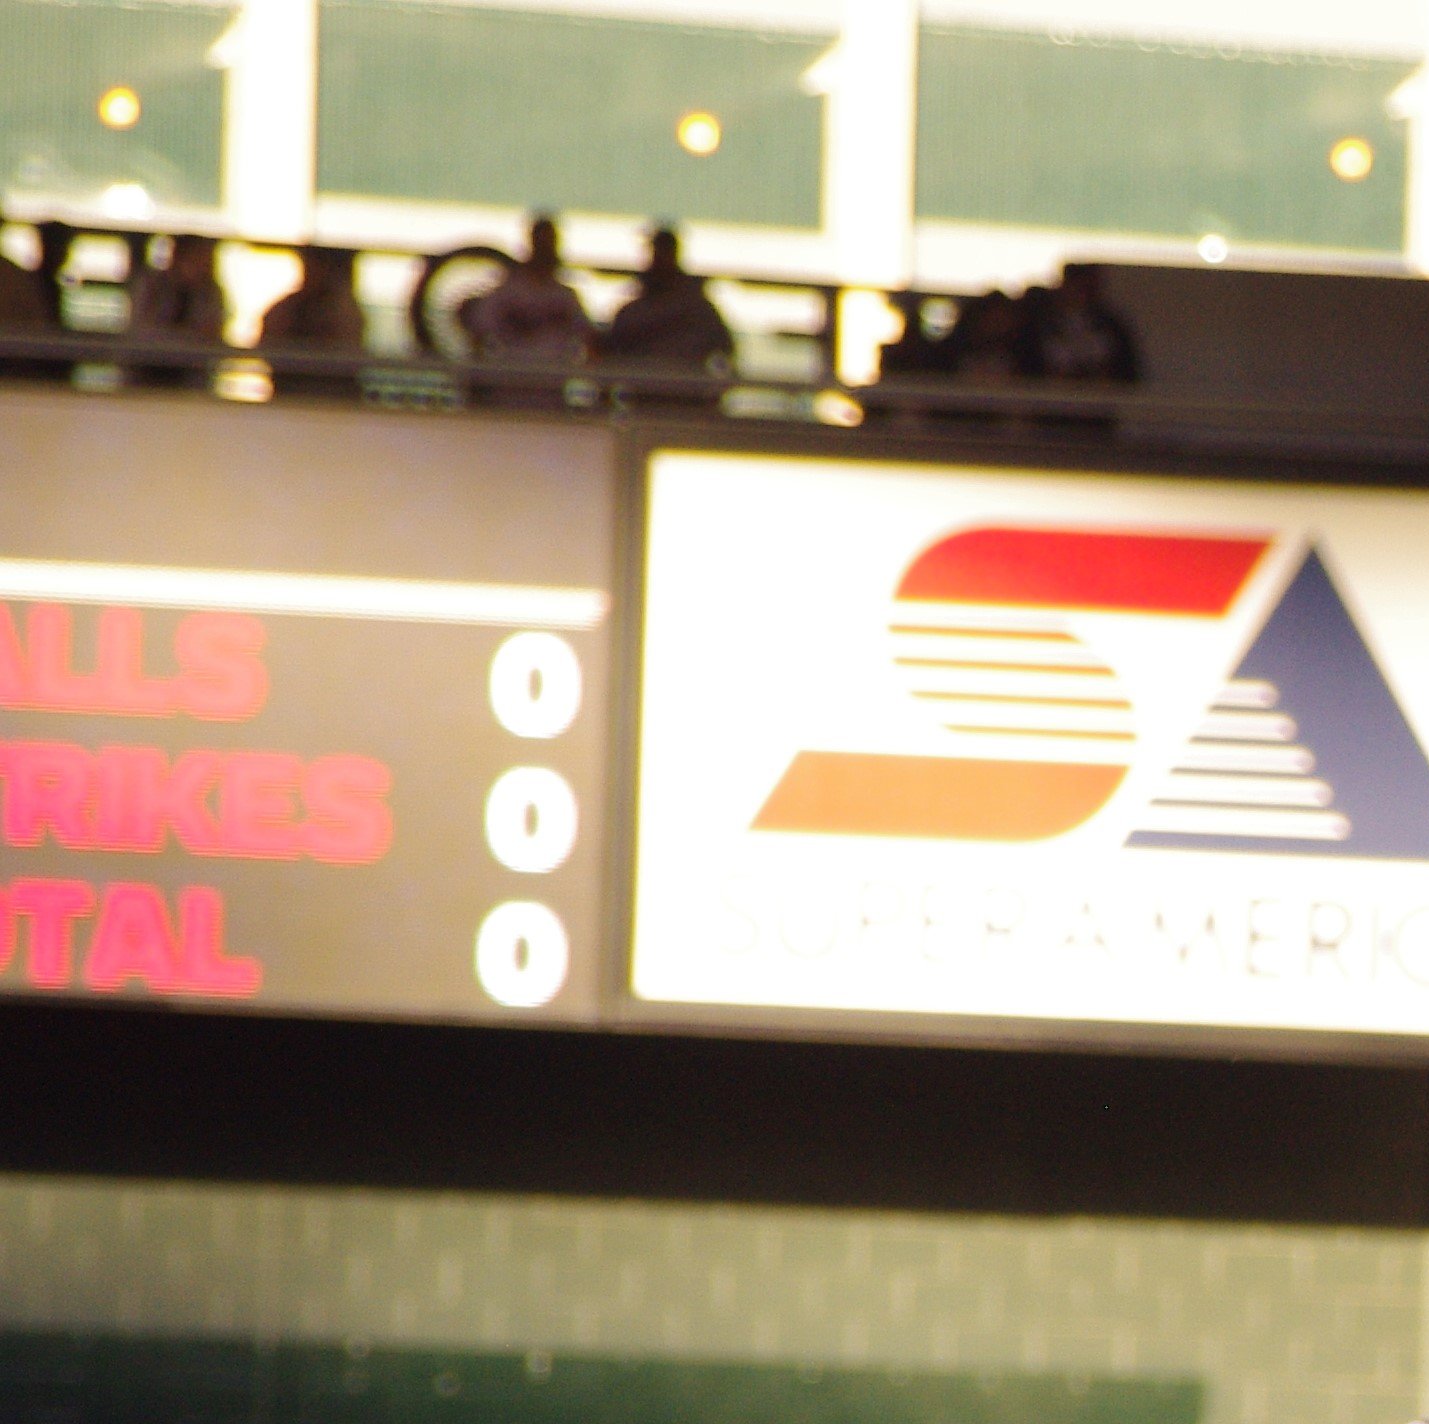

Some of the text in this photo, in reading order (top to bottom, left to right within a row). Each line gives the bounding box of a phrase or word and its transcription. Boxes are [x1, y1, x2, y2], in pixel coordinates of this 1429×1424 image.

[489, 631, 583, 739] 0
[485, 766, 579, 874] 0
[475, 901, 569, 1008] 0
